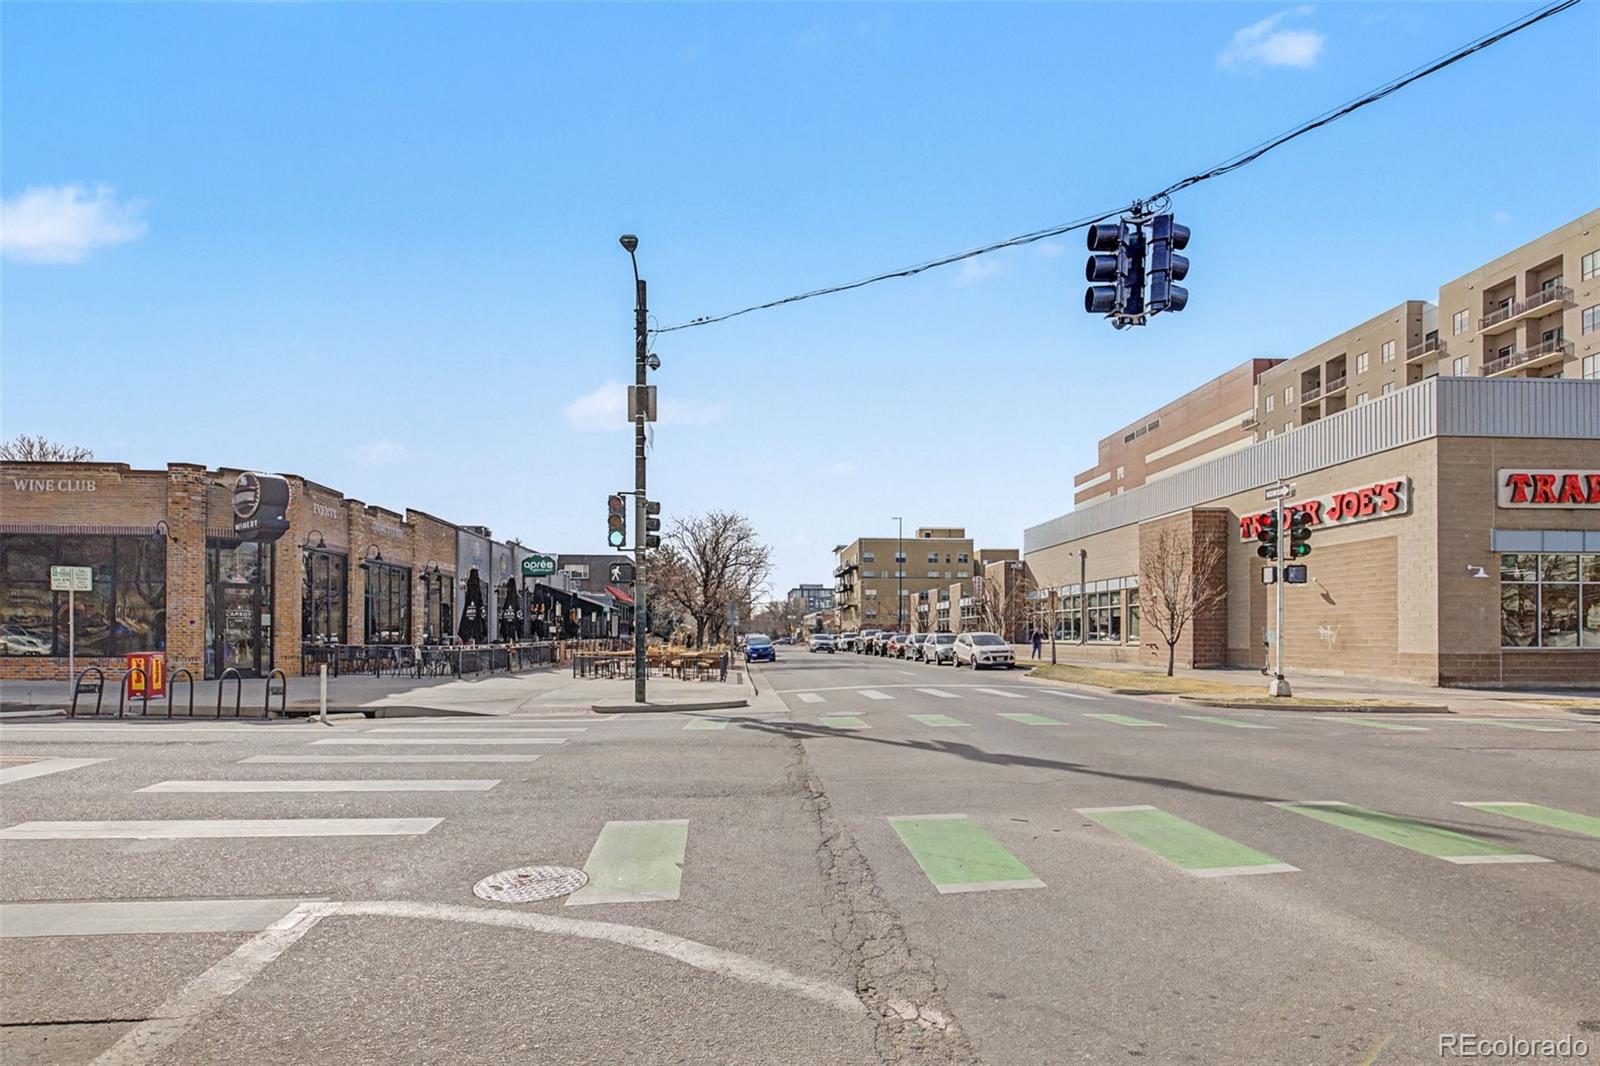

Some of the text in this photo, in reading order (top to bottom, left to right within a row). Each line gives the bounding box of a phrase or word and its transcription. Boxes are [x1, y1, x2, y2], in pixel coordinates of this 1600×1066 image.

[14, 480, 96, 491] WINE CLUB
[1326, 481, 1400, 521] JOE'S
